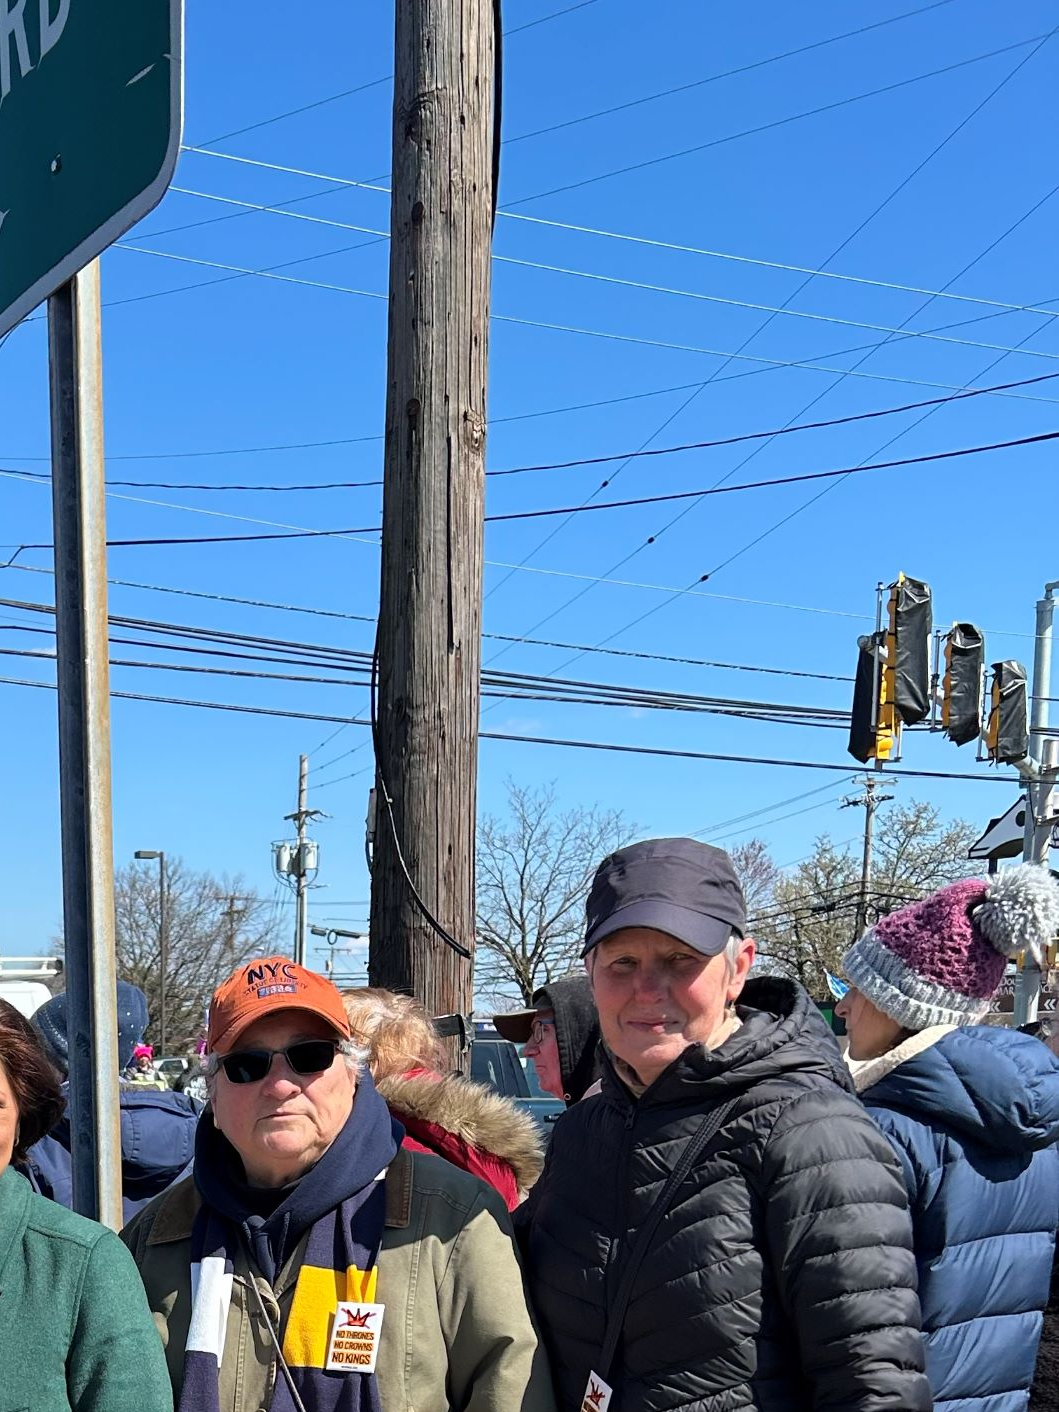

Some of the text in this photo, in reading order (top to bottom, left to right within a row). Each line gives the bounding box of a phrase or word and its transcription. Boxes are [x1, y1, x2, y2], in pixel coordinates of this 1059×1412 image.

[247, 962, 298, 985] NYC
[336, 1330, 374, 1340] NO THRONES
[333, 1340, 373, 1352] NO CROWNS
[331, 1352, 371, 1364] NO KINGS
